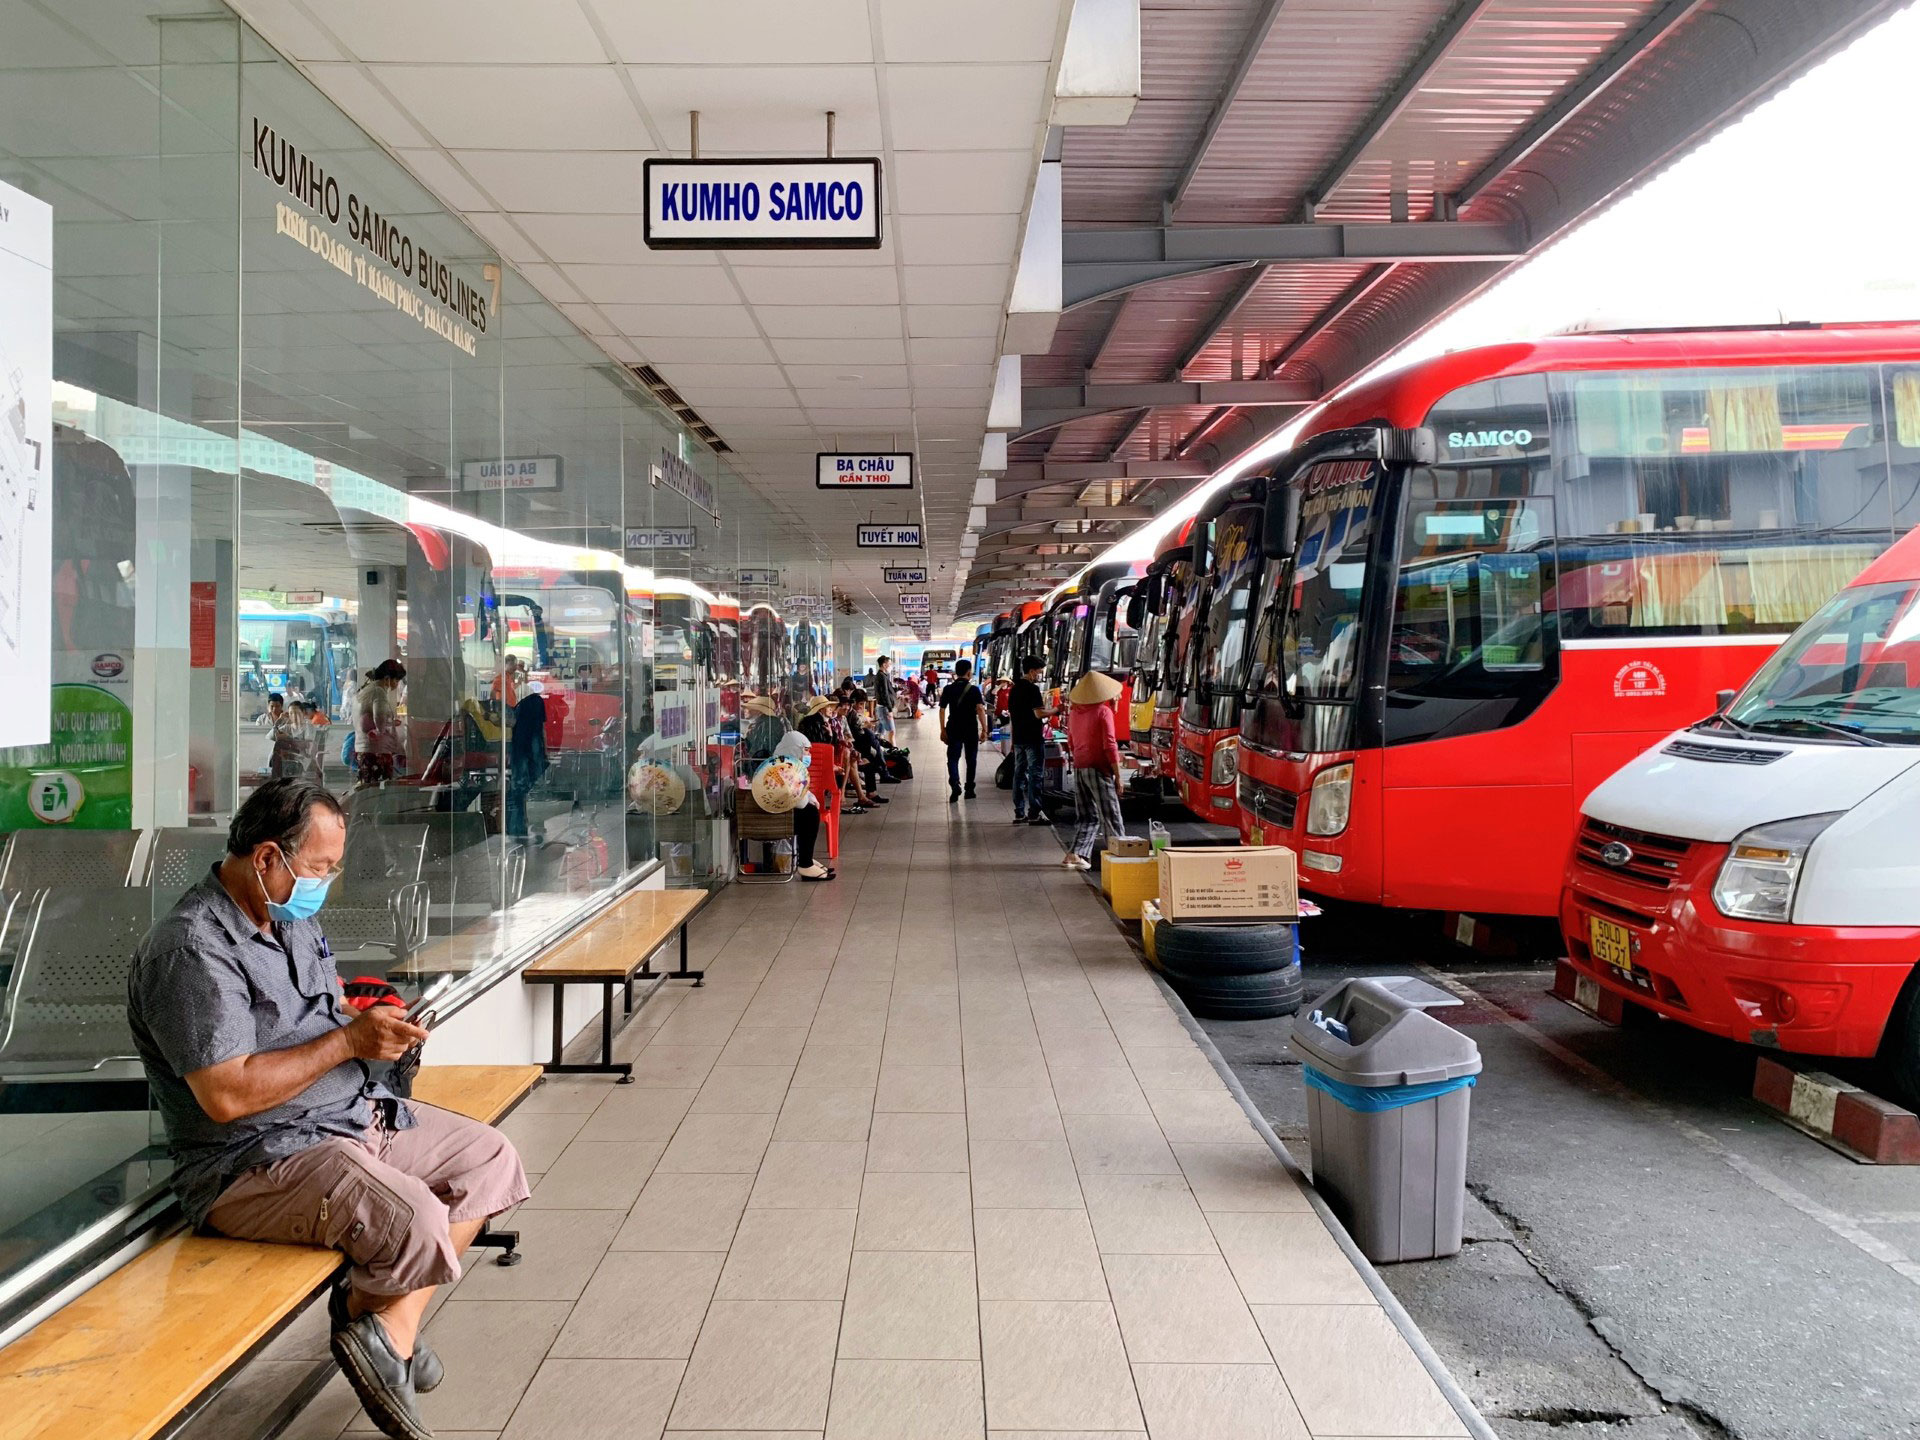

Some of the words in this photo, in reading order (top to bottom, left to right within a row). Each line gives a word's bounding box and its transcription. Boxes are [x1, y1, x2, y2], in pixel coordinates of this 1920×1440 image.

[661, 182, 761, 222] KUMHO
[768, 181, 864, 222] SAMCO
[253, 117, 340, 225] KUMHO
[348, 193, 413, 278] SAMCO
[418, 246, 486, 334] BUSLINES
[309, 223, 353, 277] DOANH
[397, 281, 423, 323] PHÚC
[1448, 429, 1533, 448] SAMCO
[836, 459, 855, 472] BA
[858, 457, 894, 472] CHÂU
[839, 472, 863, 483] (CẦN
[865, 474, 890, 483] THƠ)
[861, 527, 894, 543] TUYẾT
[897, 531, 918, 543] HON
[888, 569, 908, 580] TUẤN
[908, 572, 923, 580] NGA
[94, 661, 122, 670] SAMCO
[70, 711, 88, 735] QUY
[1598, 920, 1621, 944] 50LD
